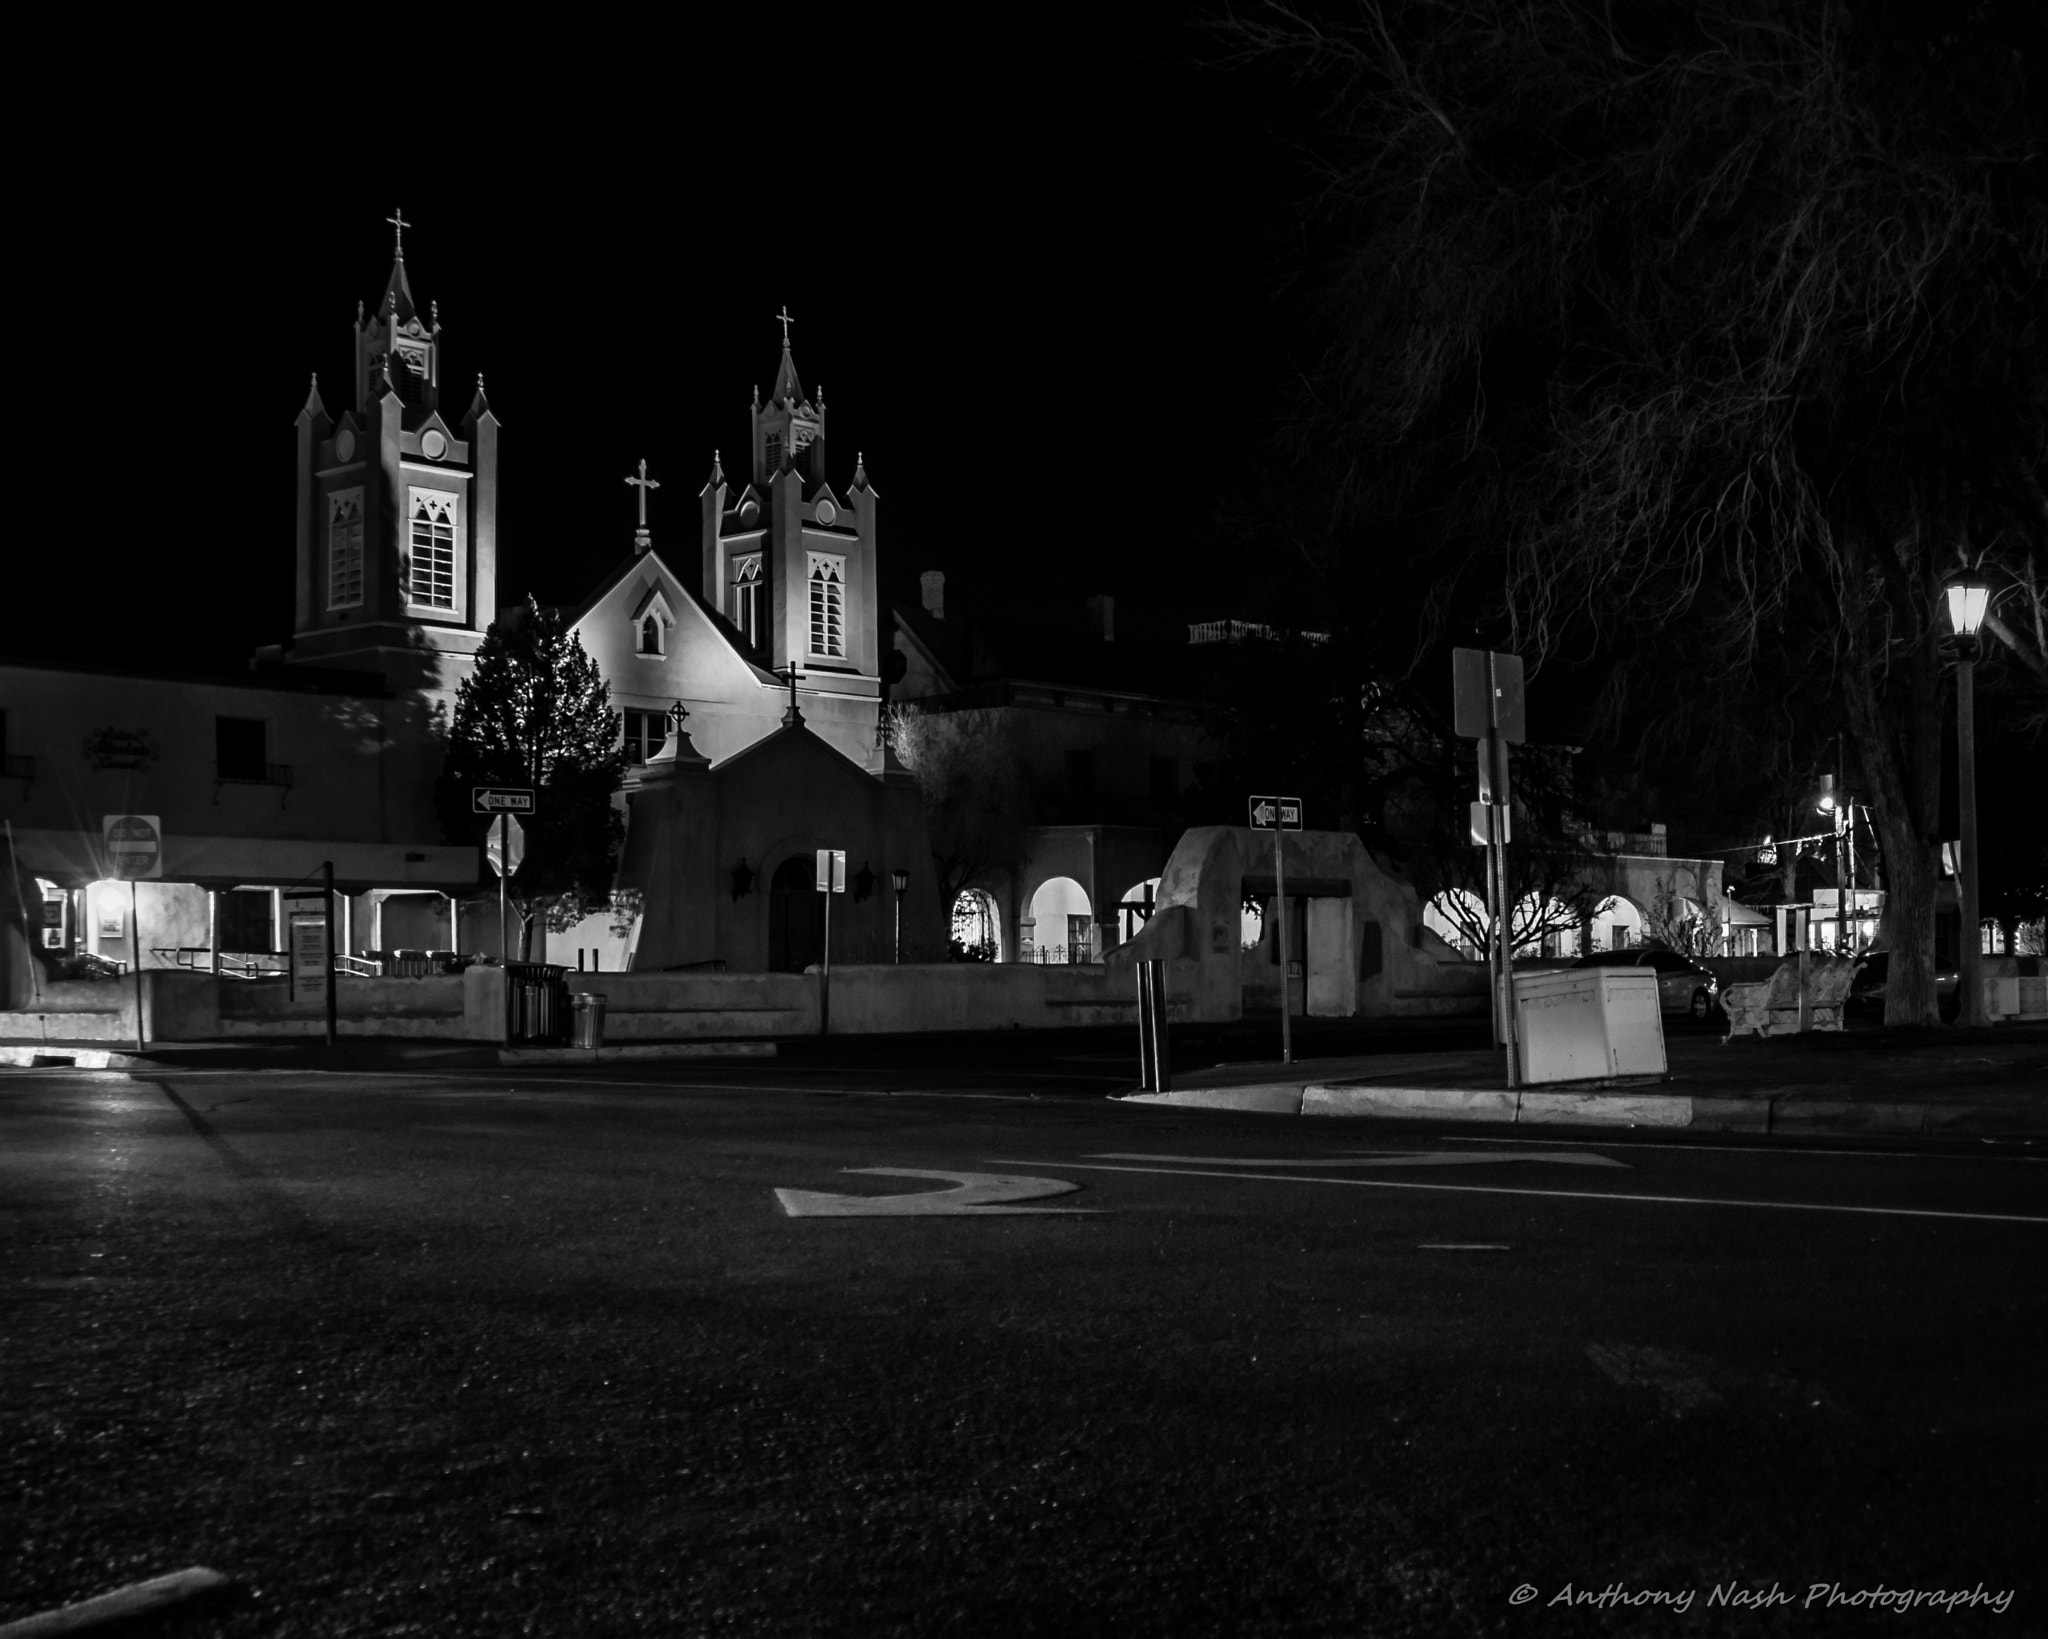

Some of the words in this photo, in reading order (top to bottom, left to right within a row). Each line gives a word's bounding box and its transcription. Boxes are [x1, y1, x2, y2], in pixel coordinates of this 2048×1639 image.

[488, 796, 506, 806] ONE
[510, 797, 528, 807] WAY
[1265, 808, 1276, 819] ON
[133, 828, 151, 838] NOT
